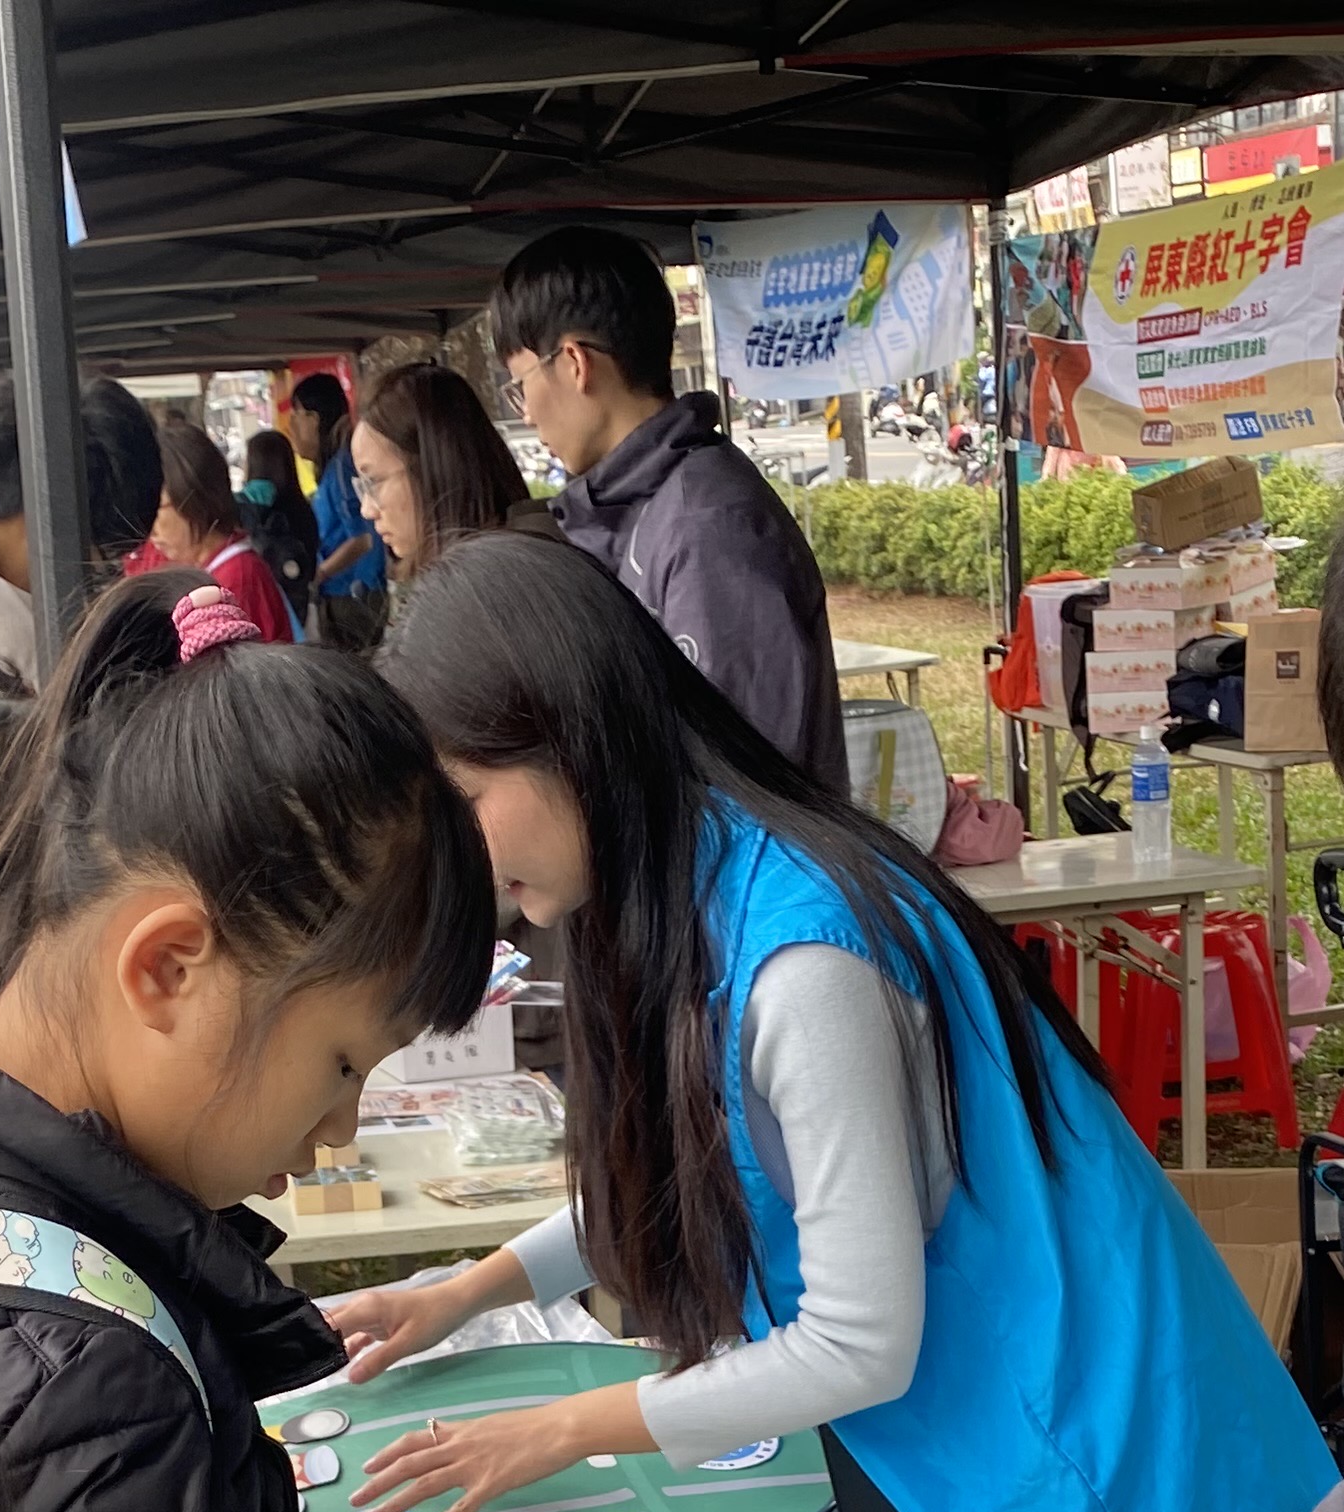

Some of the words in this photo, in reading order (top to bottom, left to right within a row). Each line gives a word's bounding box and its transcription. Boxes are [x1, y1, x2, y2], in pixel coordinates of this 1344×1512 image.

[1140, 205, 1312, 299] 屏東縣紅十字會
